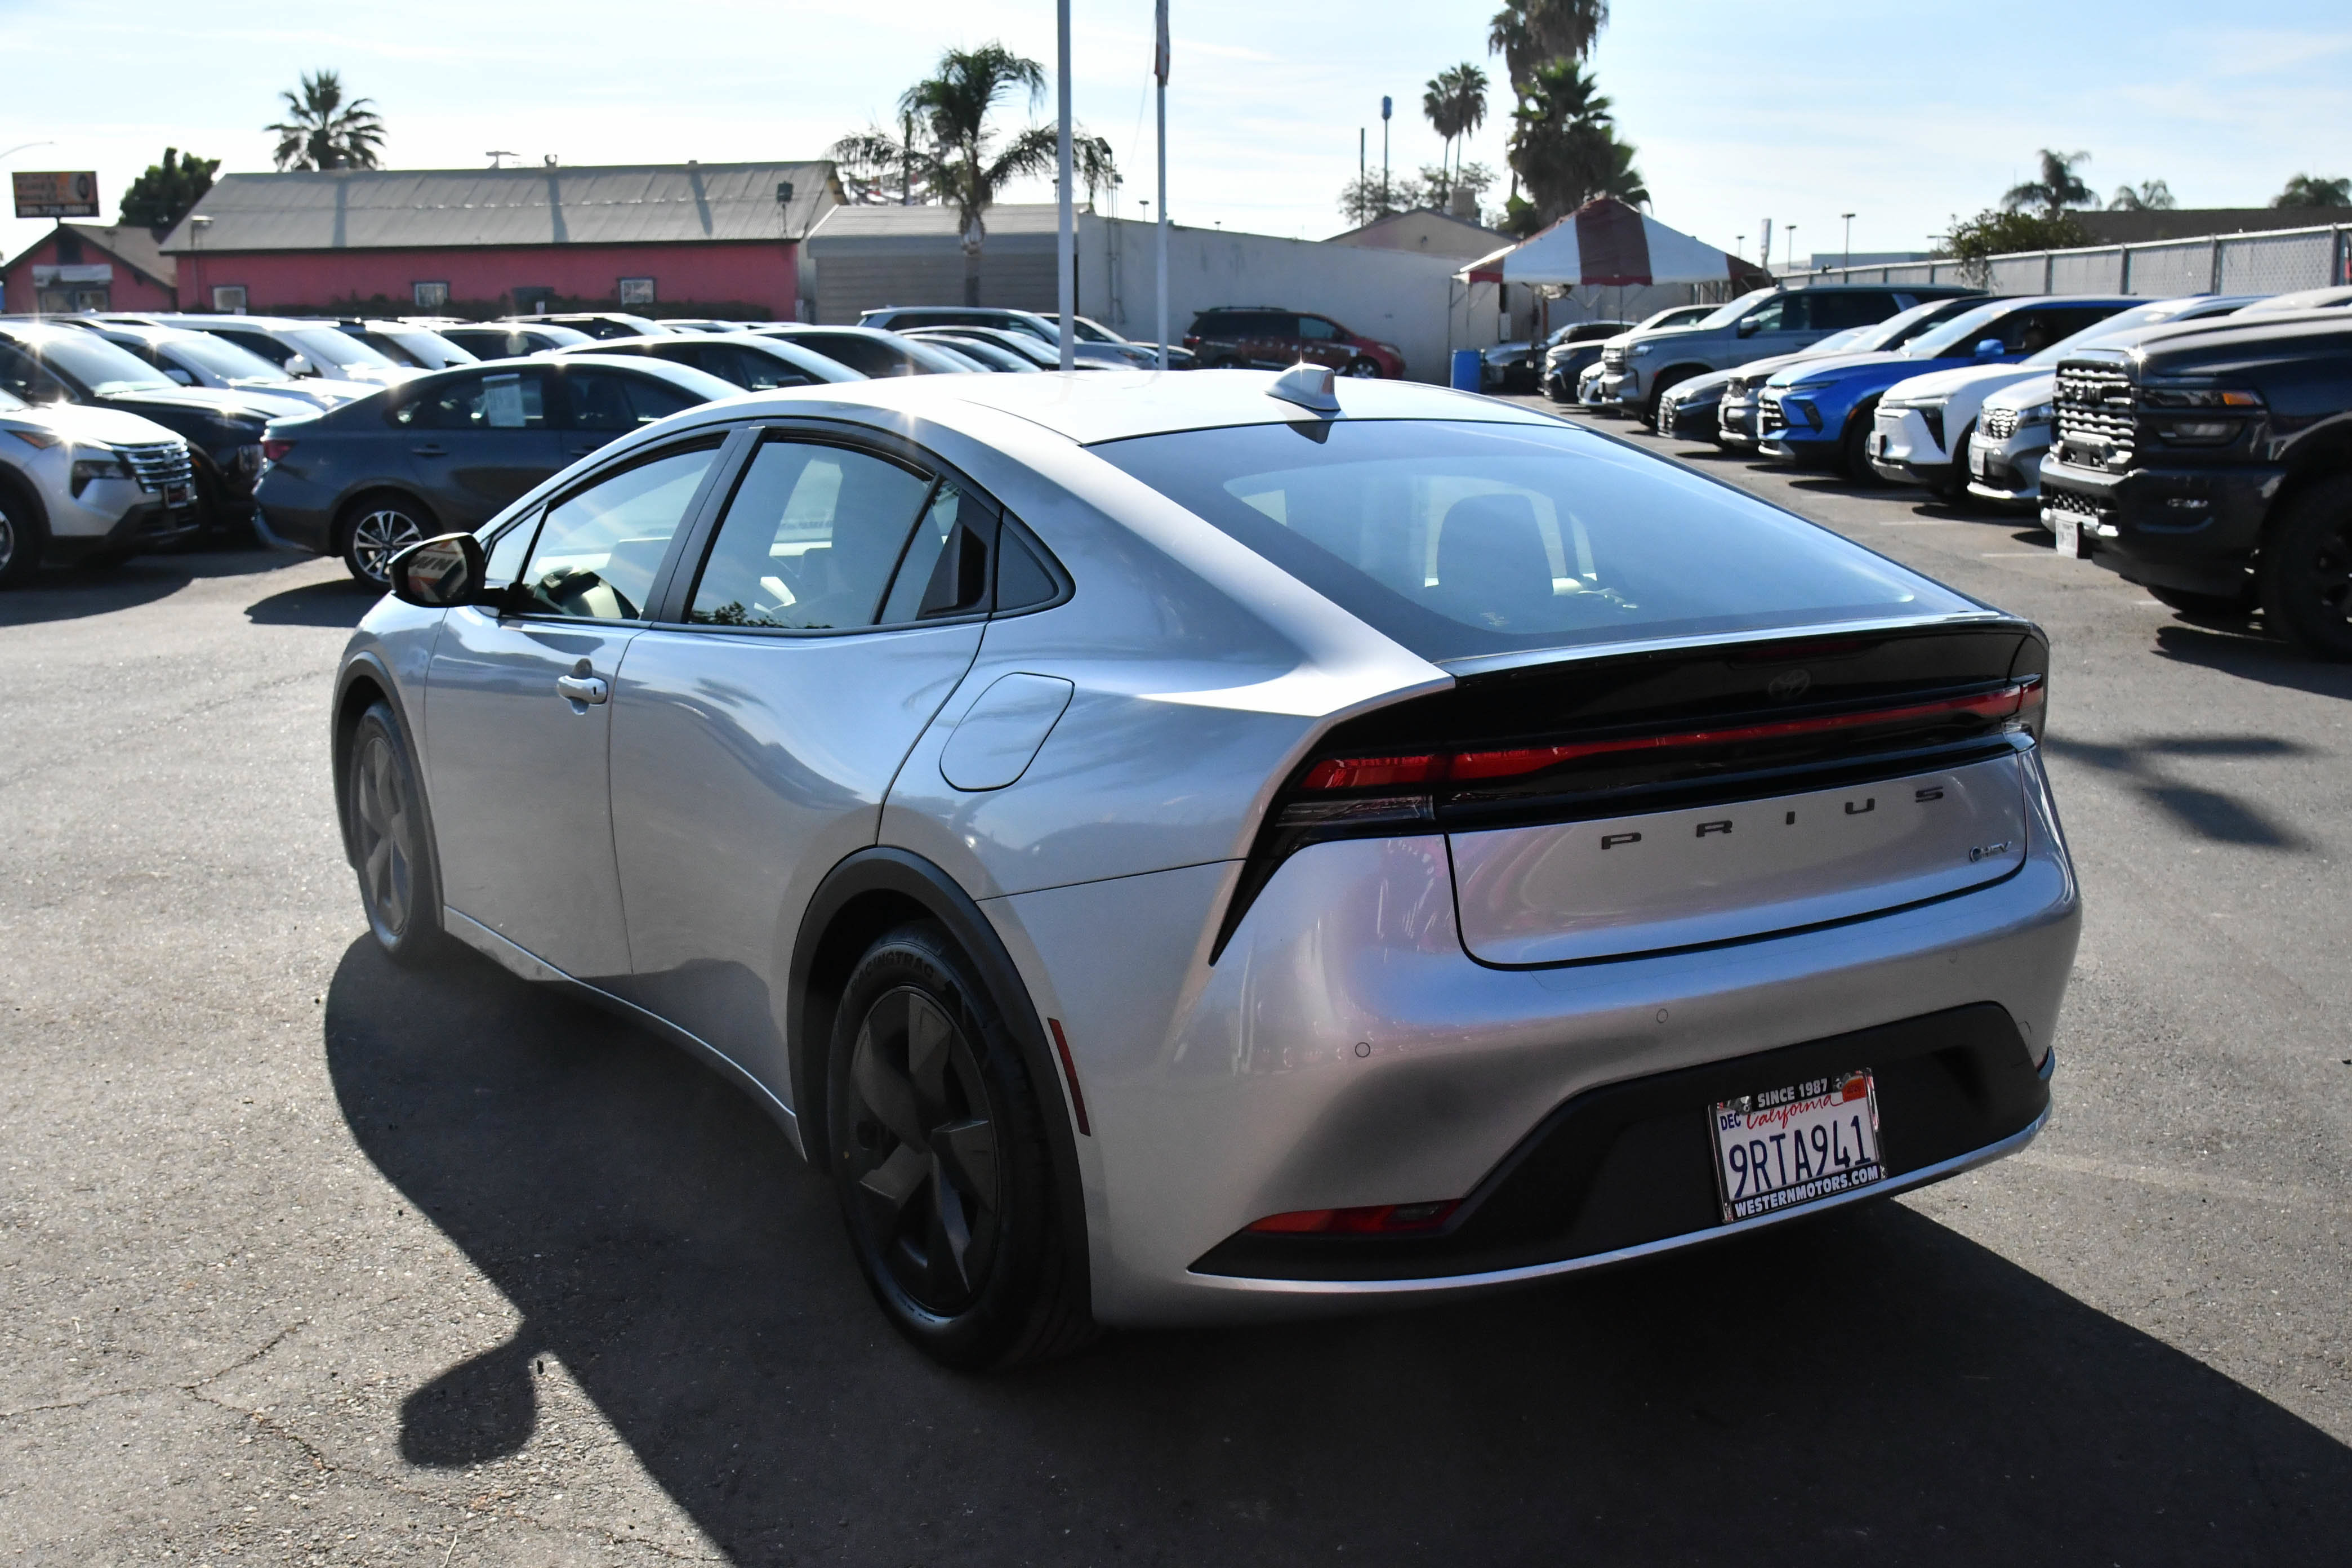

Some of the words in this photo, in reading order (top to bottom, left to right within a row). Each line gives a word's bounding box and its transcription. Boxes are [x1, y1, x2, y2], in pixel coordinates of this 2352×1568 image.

[1601, 786, 1943, 850] PRIUS
[1720, 1112, 1741, 1130] DEC
[1747, 1094, 1844, 1129] California
[1757, 1086, 1795, 1108] SINCE
[1799, 1078, 1828, 1098] 1987
[1729, 1115, 1871, 1199] 9RTA941
[1735, 1165, 1878, 1218] WESTERNMOTORS.COM
